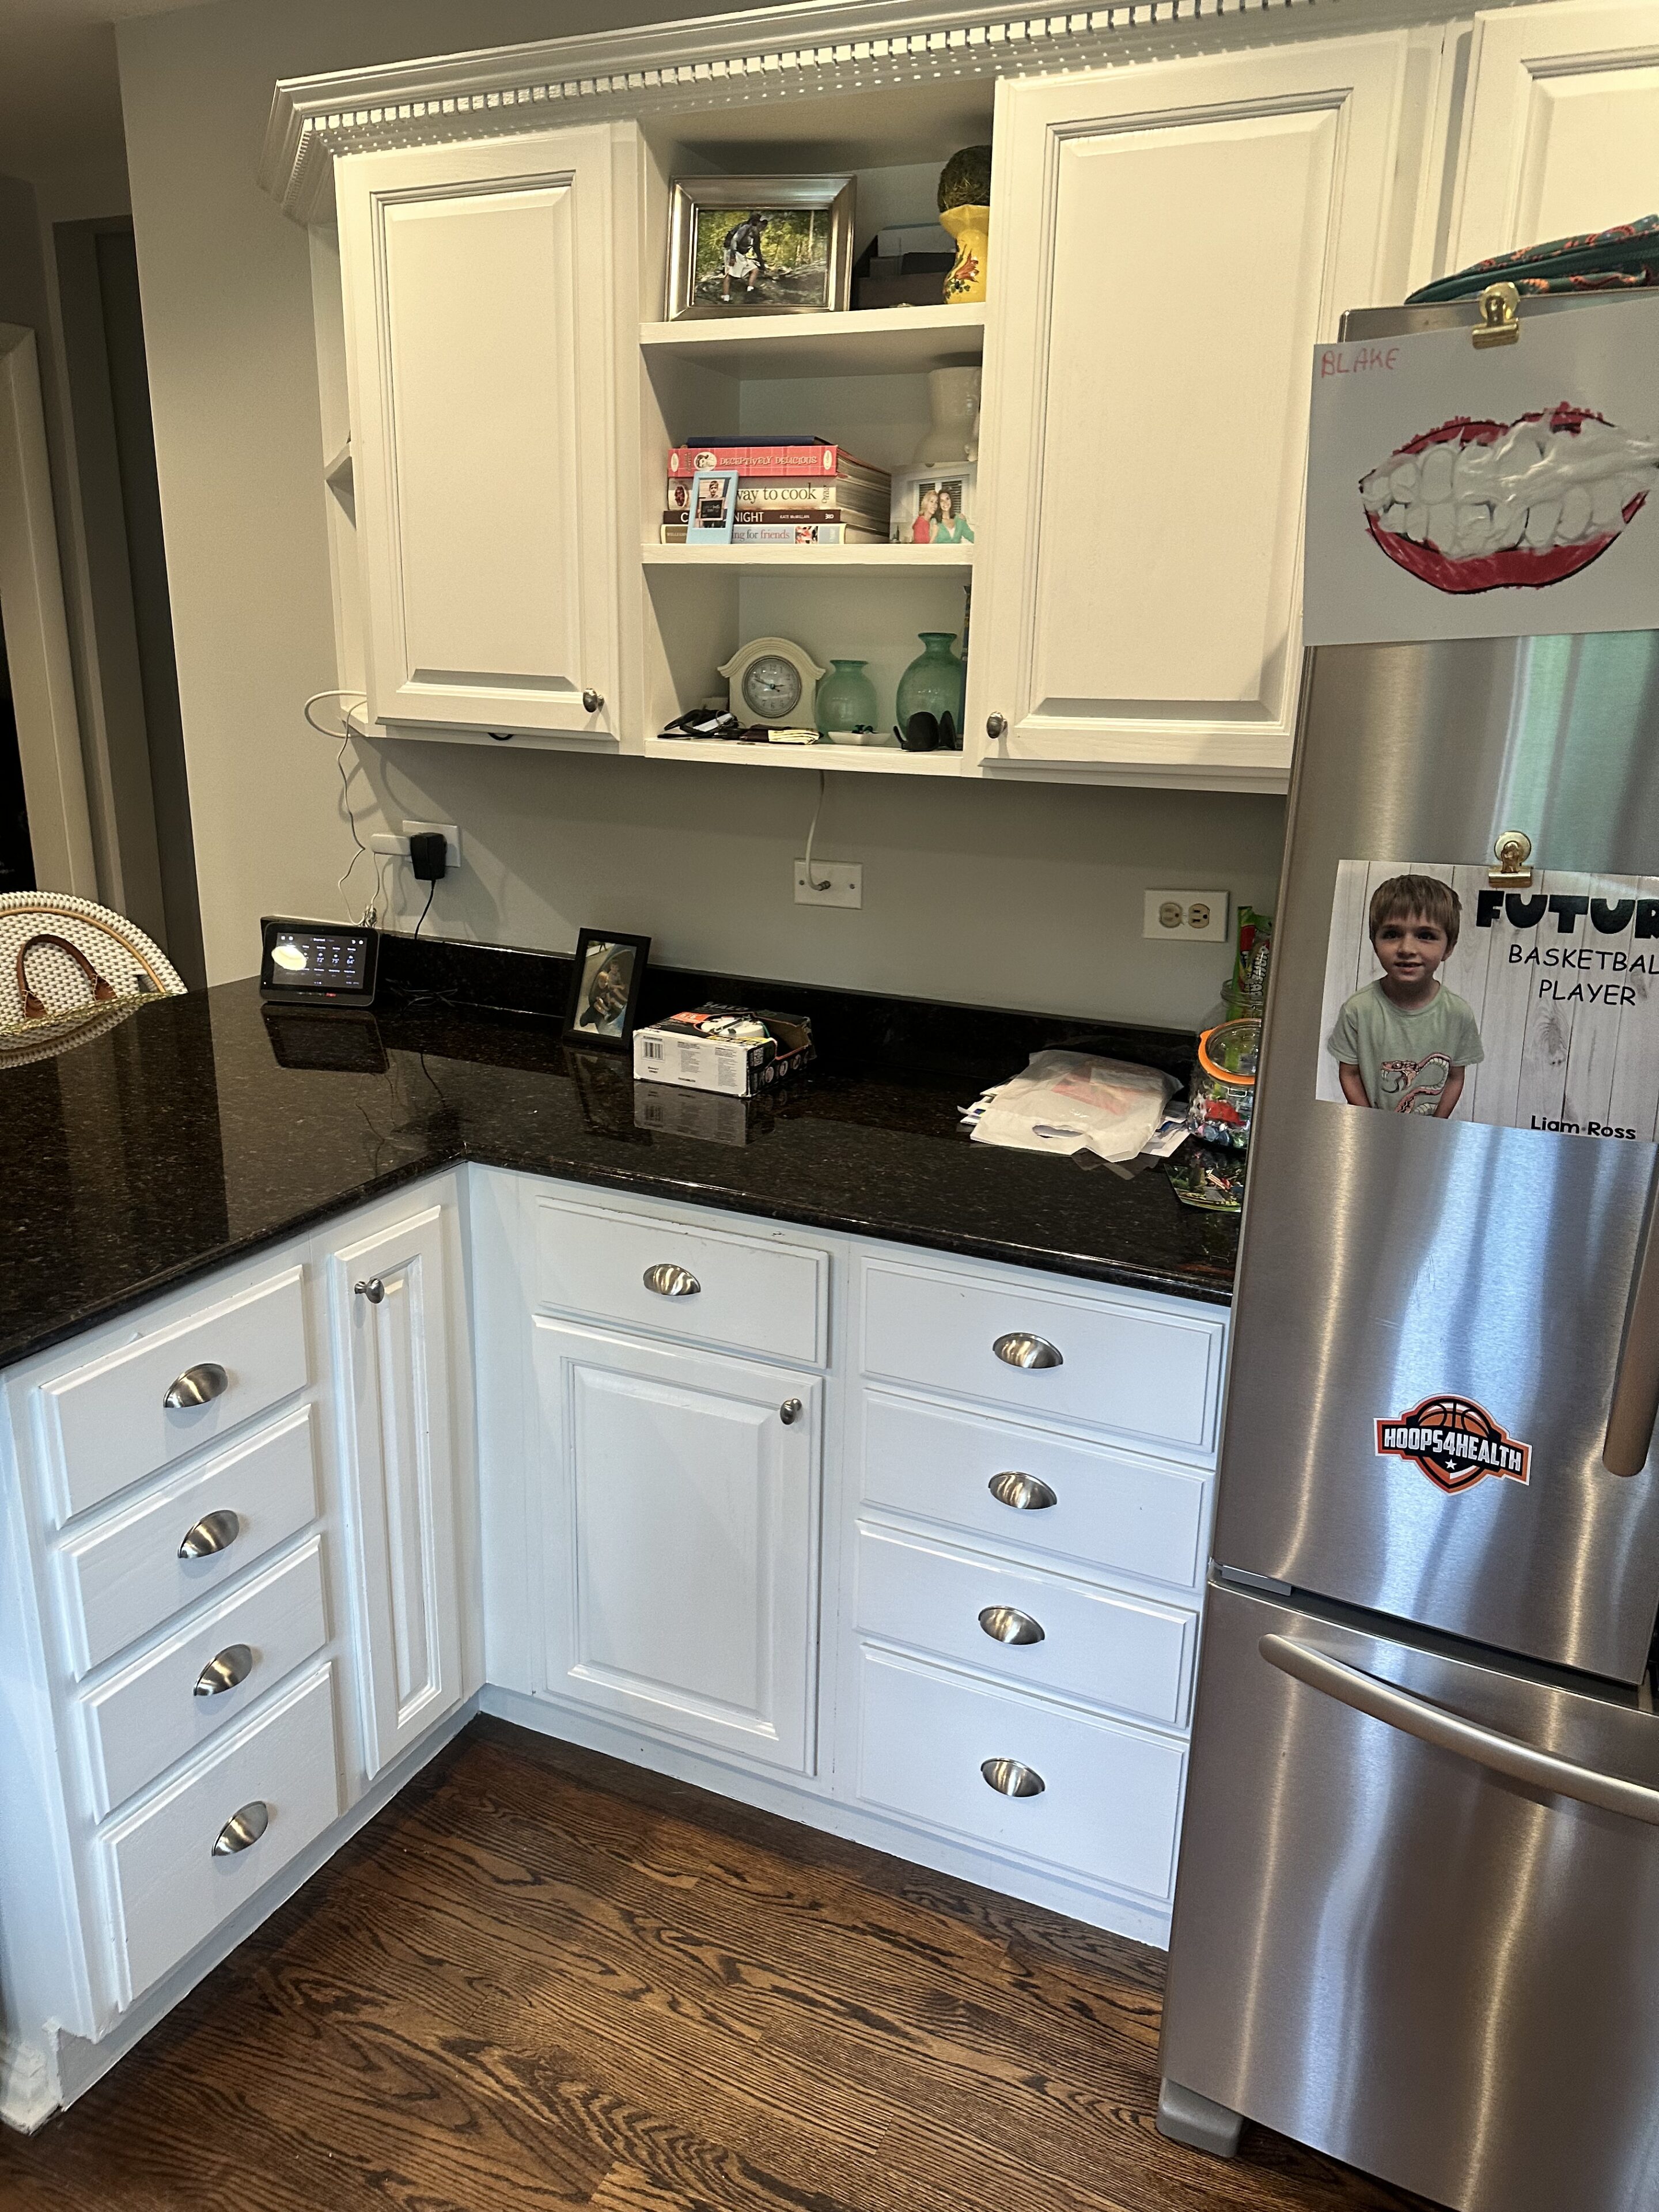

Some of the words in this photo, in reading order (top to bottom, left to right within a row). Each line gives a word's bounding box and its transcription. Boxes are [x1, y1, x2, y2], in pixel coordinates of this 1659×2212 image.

[1321, 347, 1400, 378] BLAKE
[719, 456, 773, 466] DECEPTIVELY
[775, 456, 817, 465] DELICIOUS
[763, 487, 778, 501] to
[781, 482, 817, 500] cook
[747, 529, 759, 539] for
[760, 529, 790, 539] friends
[1476, 890, 1659, 939] FUTUR
[1508, 944, 1659, 975] BASKETBAL
[1539, 979, 1636, 1006] PLAYER
[1531, 1115, 1580, 1134] Liam
[1588, 1121, 1636, 1140] Ross
[1384, 1427, 1522, 1472] HOOPS4HEALTH
